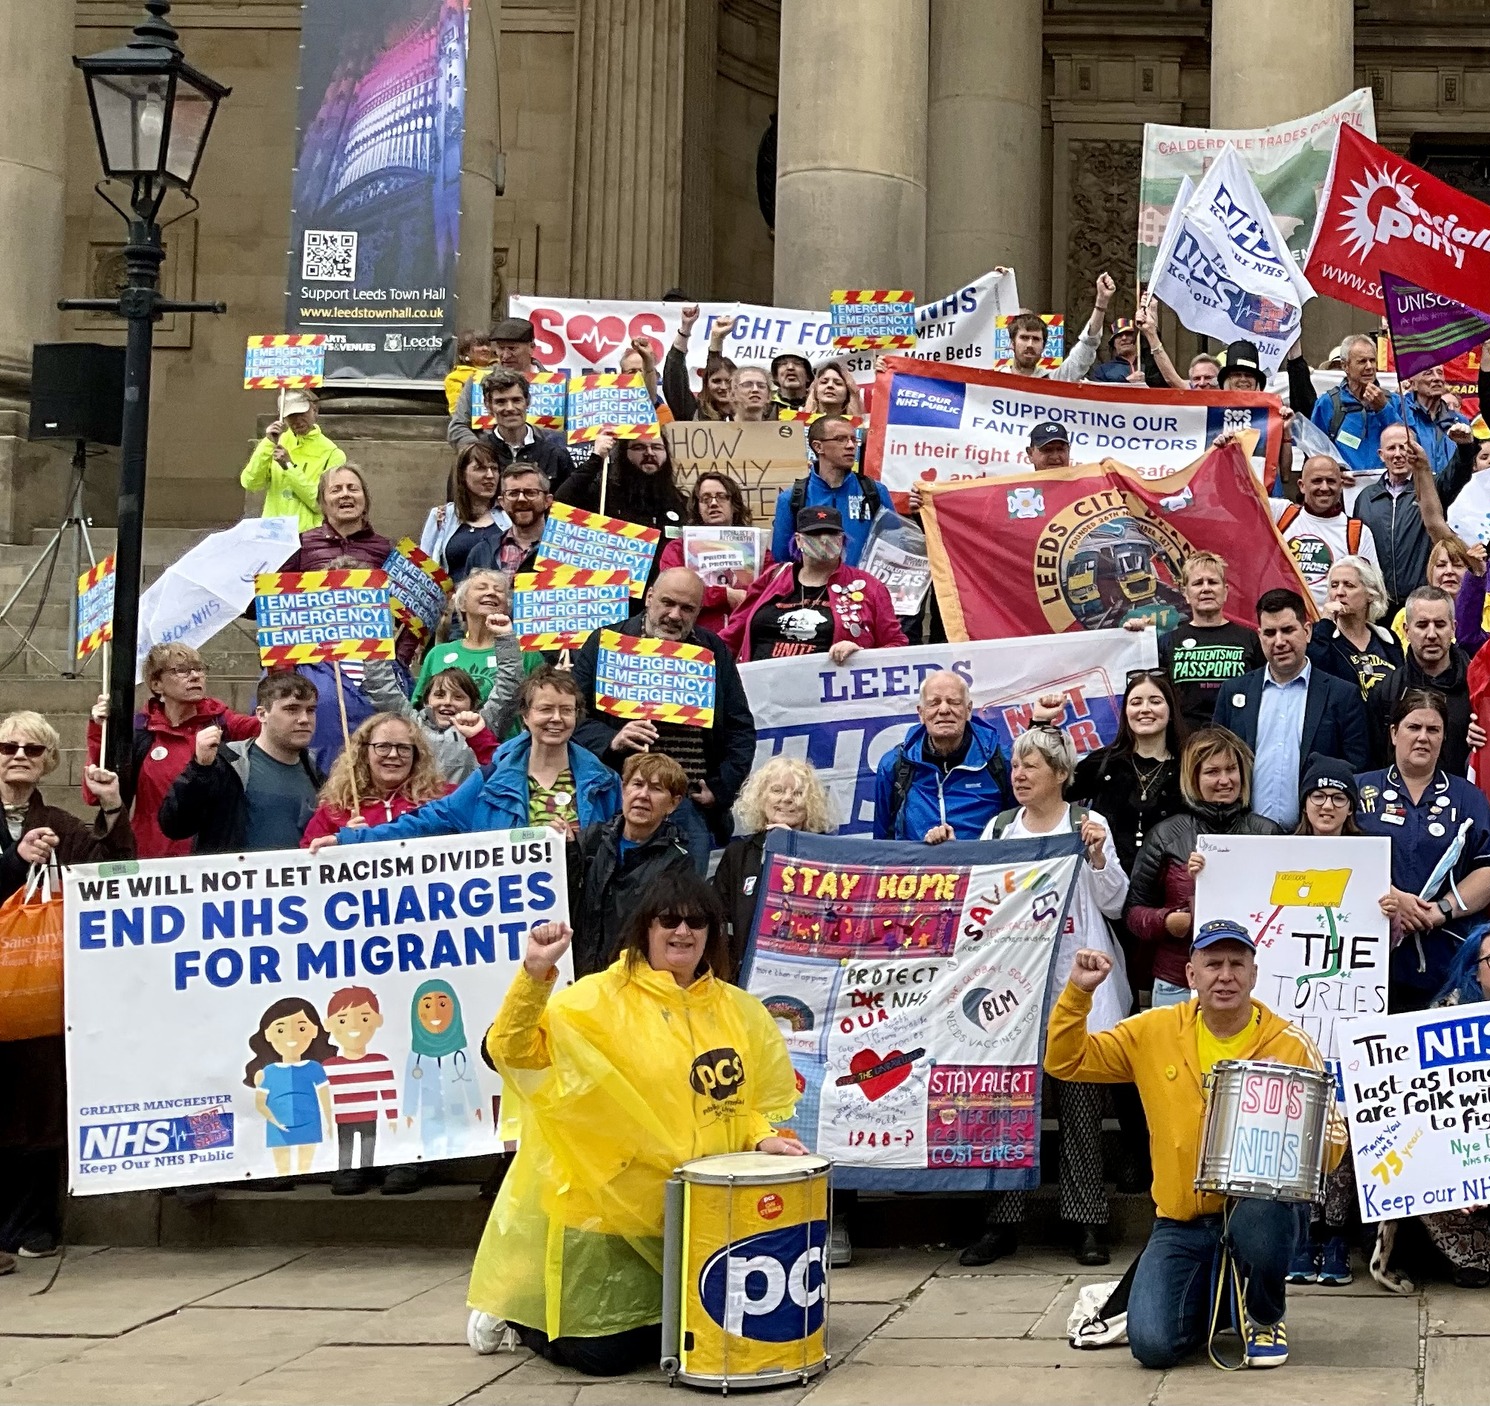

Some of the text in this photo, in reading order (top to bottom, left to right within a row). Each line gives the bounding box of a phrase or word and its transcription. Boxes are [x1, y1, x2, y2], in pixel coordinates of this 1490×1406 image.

[1258, 128, 1307, 148] TRADES
[1375, 205, 1466, 270] Party
[301, 286, 445, 301] Support Leeds Town Hall
[921, 287, 978, 322] NHS
[300, 307, 443, 319] www.leedstownhall.co.uk
[705, 315, 791, 341] FGHT
[403, 335, 442, 348] Leeds
[946, 344, 982, 361] Beds
[896, 397, 961, 414] NHS PUBLIC
[897, 388, 952, 405] KEEP OUR
[992, 400, 1177, 432] SUPPORTING OUR
[672, 427, 743, 459] HOW
[972, 416, 1197, 451] FANTIC DOCTORS
[891, 441, 1012, 464] in their fight
[1036, 489, 1127, 605] LEEDS CITY
[1290, 540, 1324, 553] STAFF
[709, 560, 744, 568] PROTEST
[871, 566, 926, 587] IDEAS
[191, 599, 223, 629] NHS
[1173, 661, 1245, 678] PASSPORTS
[79, 842, 552, 900] WE WILL NOT LET RACISM DIVIDE US!
[781, 865, 960, 900] STAY HOME
[79, 870, 557, 950] END NHS CHARGES
[174, 919, 553, 991] FOR MIGRANT
[1292, 932, 1379, 970] THE
[848, 967, 939, 985] PROTECT
[892, 990, 932, 1008] NHS
[982, 990, 1019, 1021] BLM
[1272, 974, 1386, 1014] TORIES
[840, 1009, 889, 1034] OUR
[1353, 1033, 1409, 1068] The
[931, 1071, 1034, 1093] STAY ALERT
[1355, 1076, 1403, 1104] last
[1410, 1073, 1441, 1092] as
[80, 1094, 232, 1116] GREATER MANCHESTER
[1241, 1075, 1304, 1120] SOS
[1356, 1103, 1398, 1124] are
[1404, 1088, 1454, 1116] folk
[1430, 1109, 1458, 1132] to
[82, 1120, 172, 1160] NHS
[1233, 1127, 1300, 1178] NHS
[1358, 1134, 1386, 1158] Thank
[1450, 1137, 1482, 1158] Nye
[80, 1149, 234, 1175] Keep Our NHS Public
[931, 1146, 974, 1164] COST
[1370, 1128, 1425, 1187] 75 years
[1462, 1156, 1482, 1167] NHS
[1362, 1183, 1416, 1218] Keep
[1423, 1186, 1458, 1204] our
